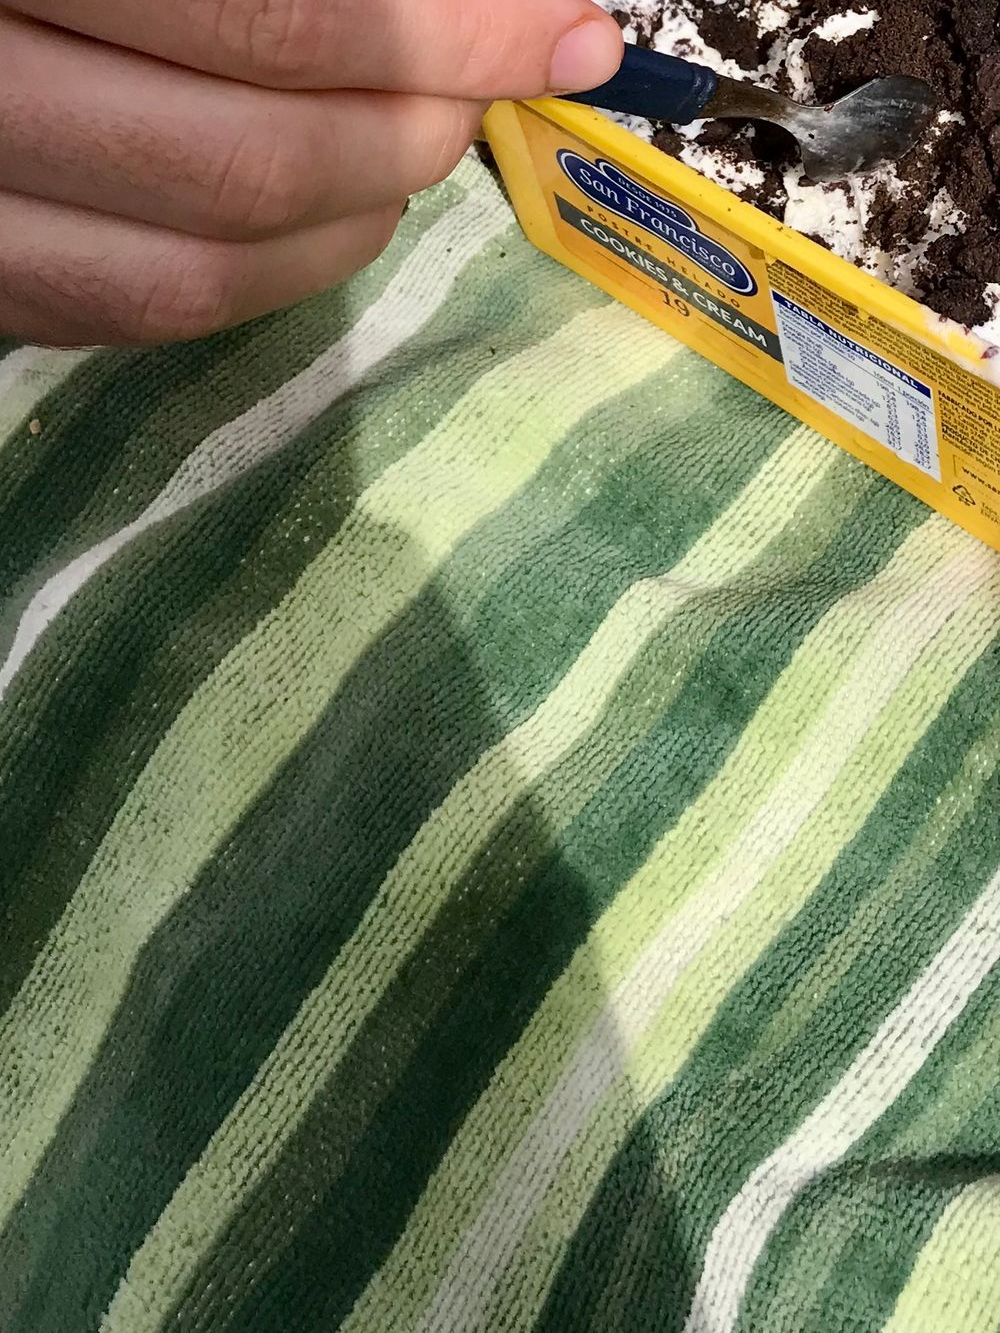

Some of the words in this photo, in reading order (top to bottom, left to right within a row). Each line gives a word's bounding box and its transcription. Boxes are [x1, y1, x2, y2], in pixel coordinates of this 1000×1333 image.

[579, 167, 621, 205] San
[625, 197, 736, 277] Francisco
[587, 204, 654, 252] POSTRE
[666, 256, 741, 309] HELADO
[580, 218, 669, 283] COOKIES
[672, 277, 690, 297] &
[692, 291, 769, 348] CREAM
[783, 298, 826, 331] TABLA
[827, 325, 918, 390] NUTRICIONAL
[937, 390, 977, 419] FABRICADO
[976, 414, 993, 429] POR
[977, 444, 989, 457] DE
